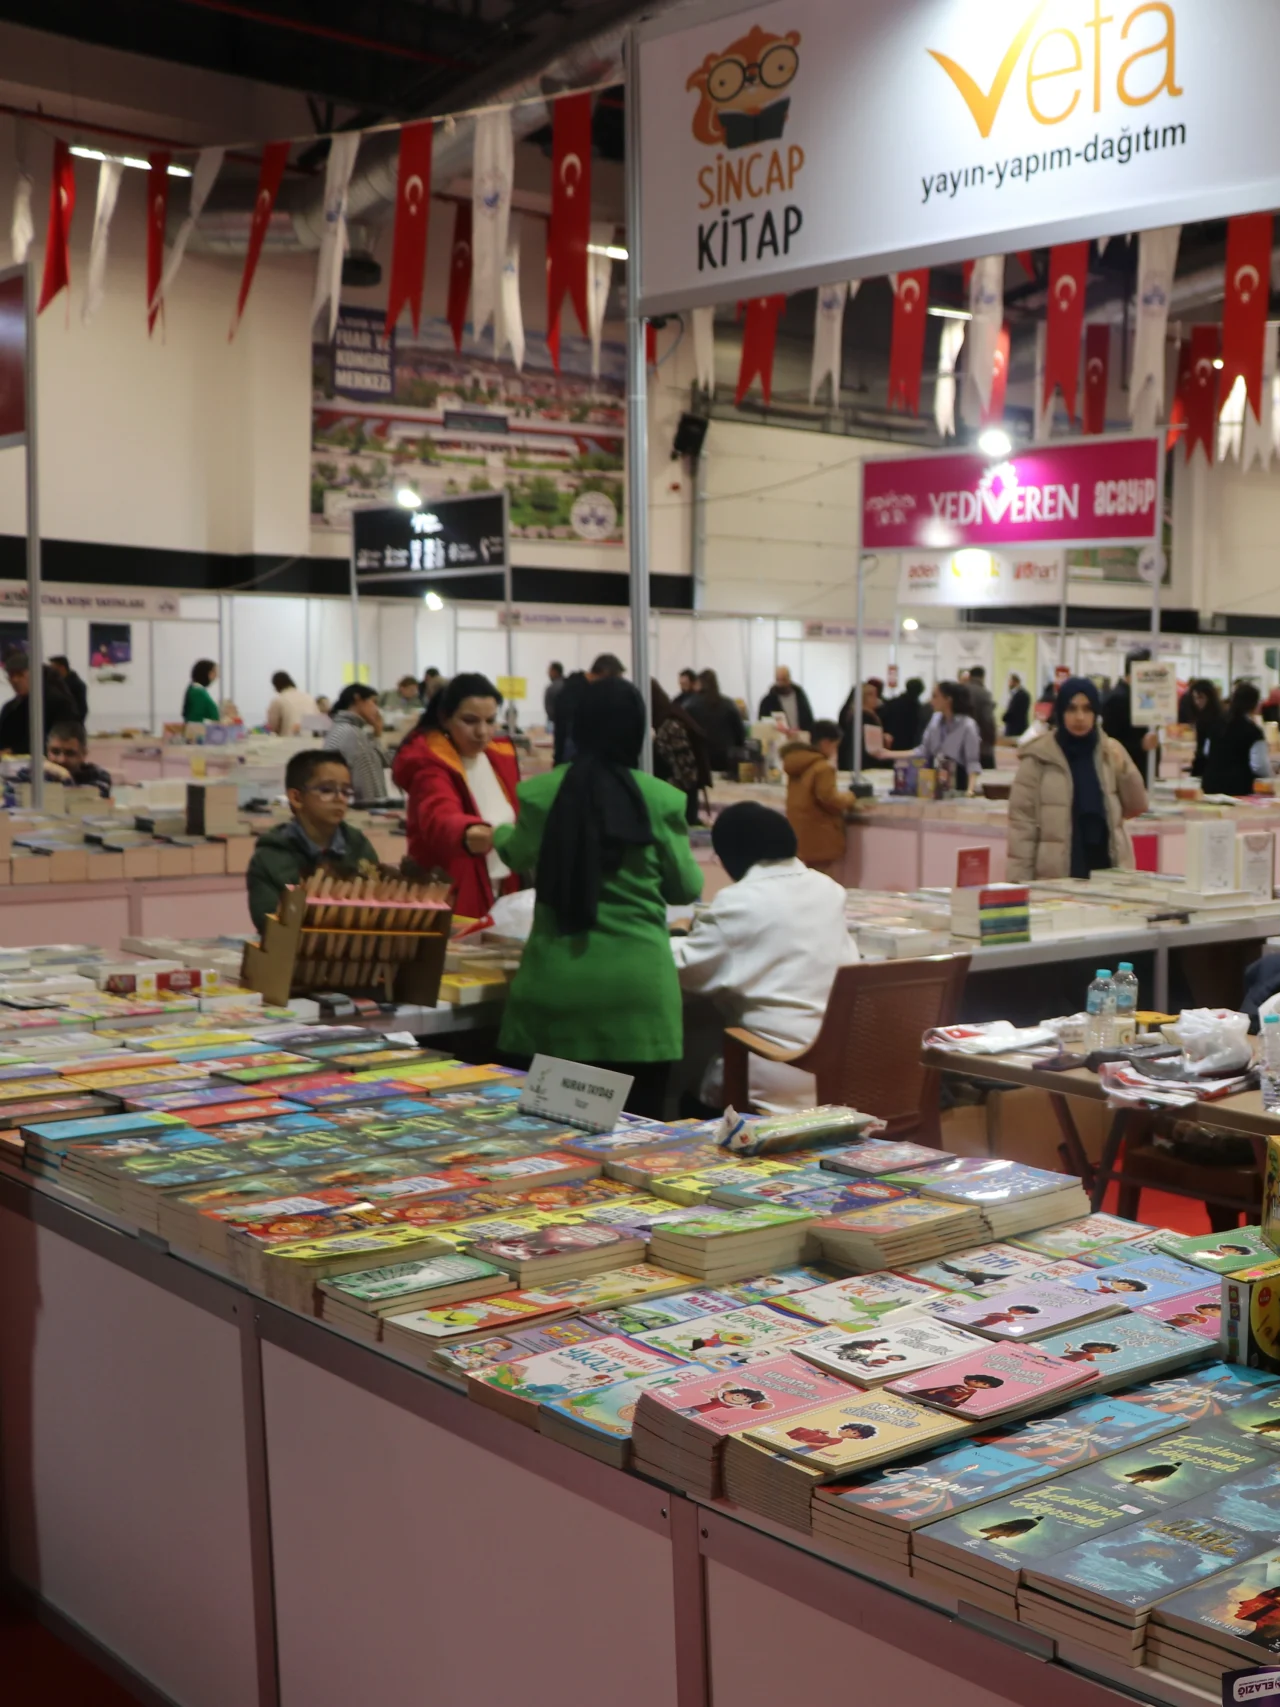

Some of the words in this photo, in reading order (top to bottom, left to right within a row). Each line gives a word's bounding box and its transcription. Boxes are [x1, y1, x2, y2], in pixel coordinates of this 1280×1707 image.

[697, 143, 806, 210] SİNCAP
[922, 122, 1187, 204] yayın-yapım-dağıtım
[697, 204, 804, 272] KİTAP
